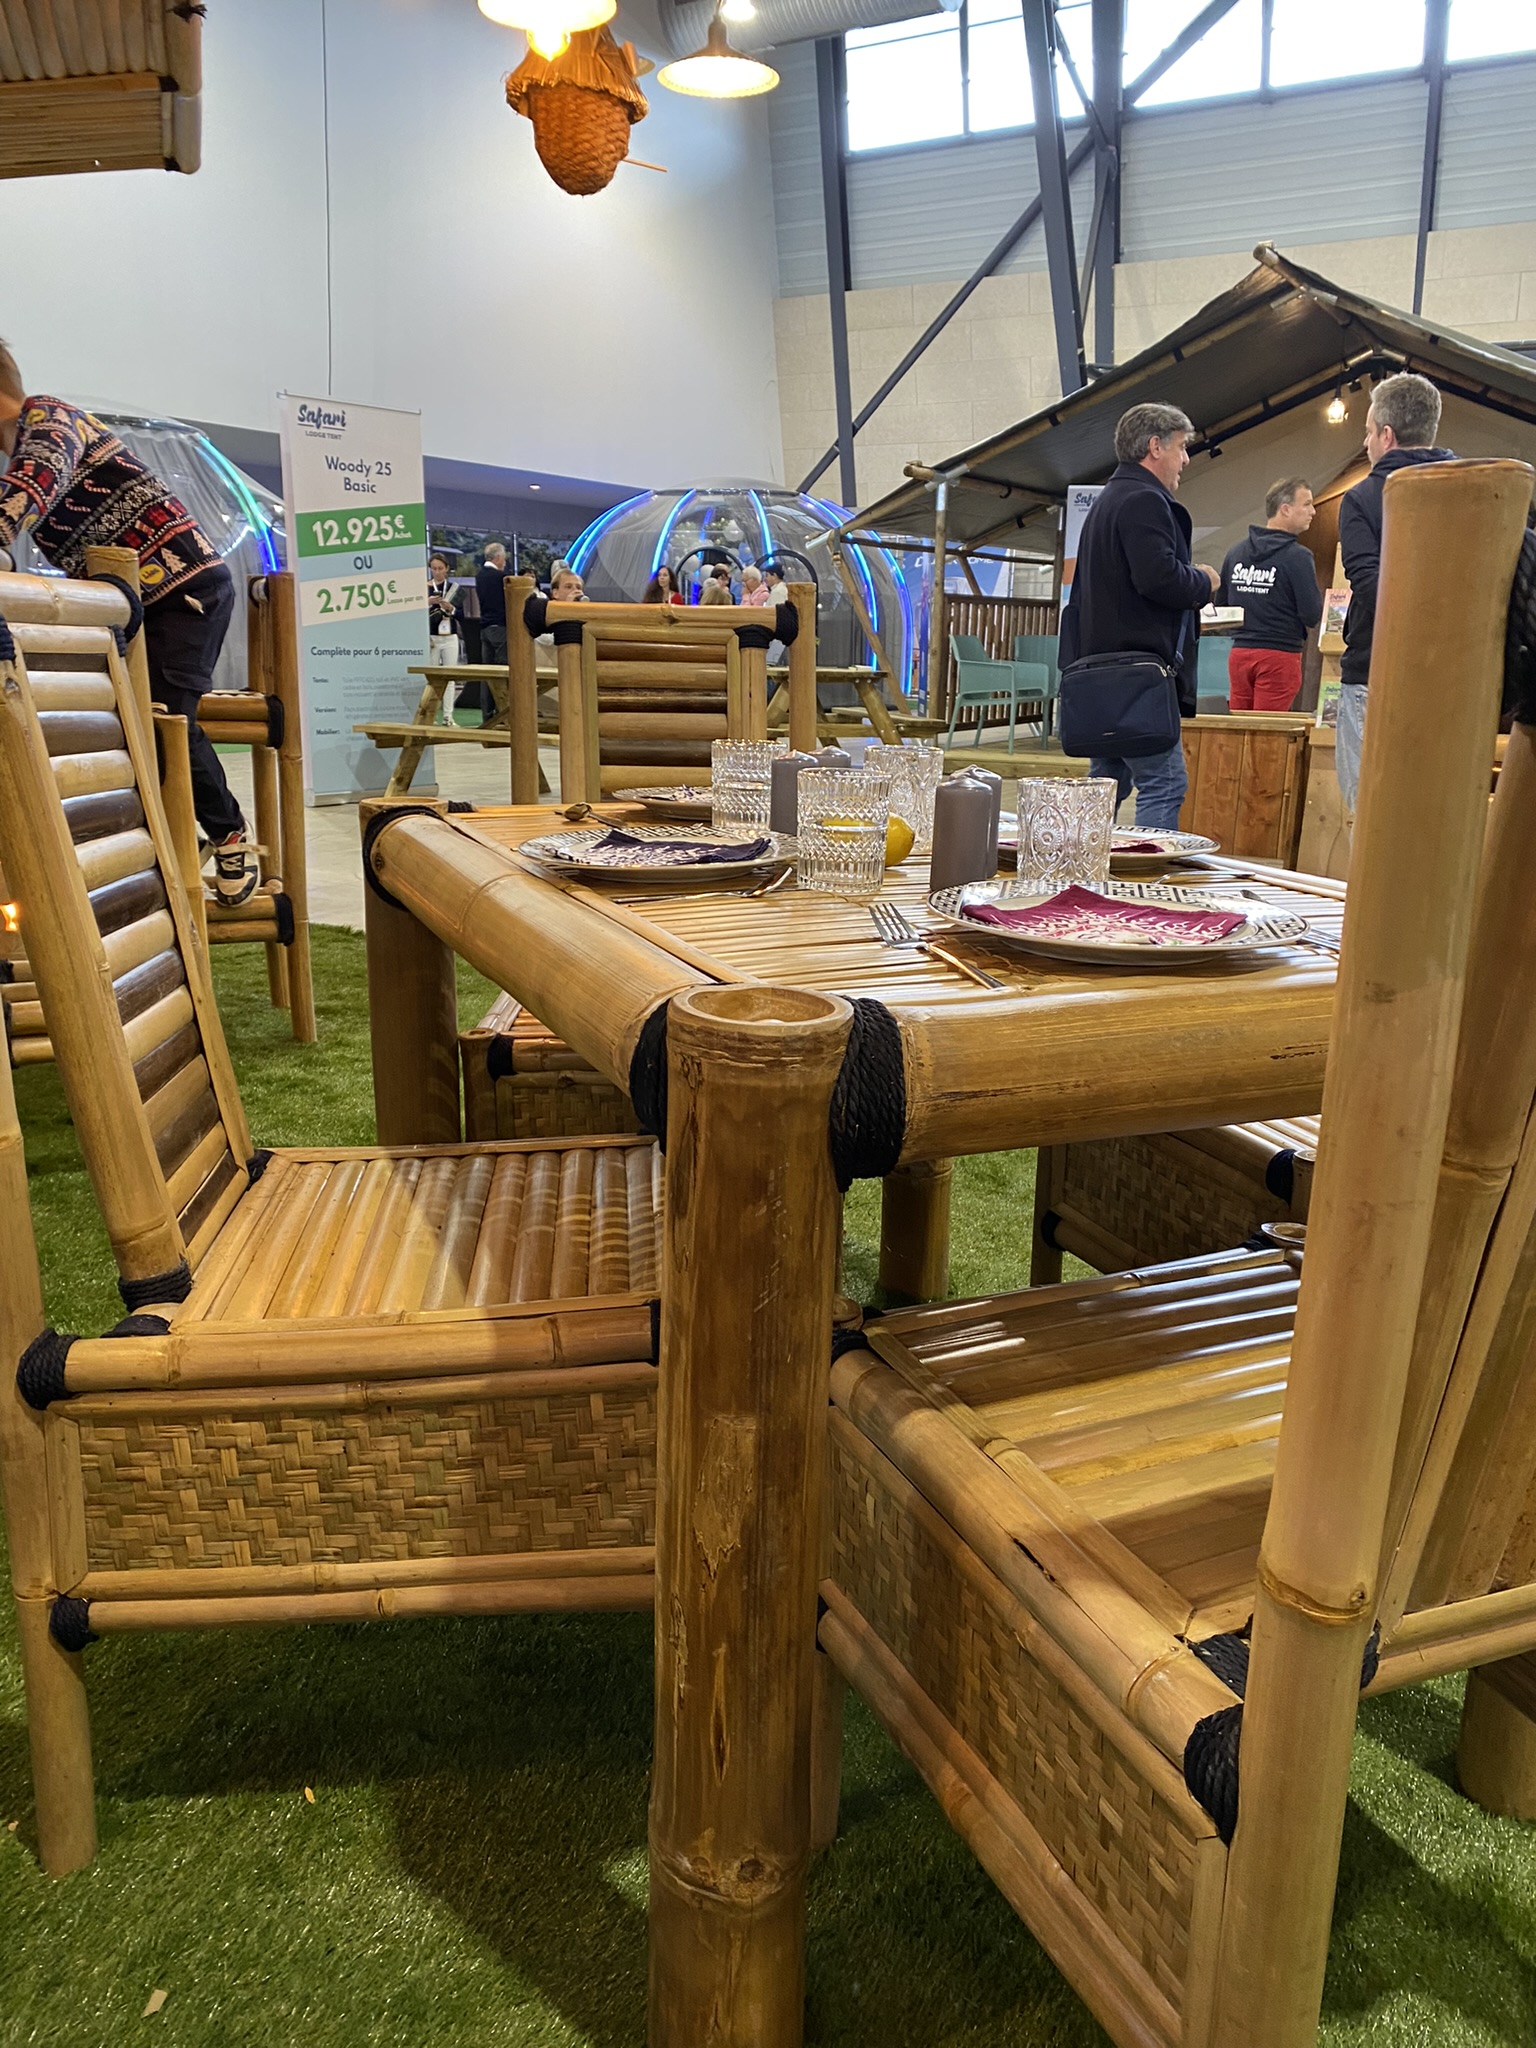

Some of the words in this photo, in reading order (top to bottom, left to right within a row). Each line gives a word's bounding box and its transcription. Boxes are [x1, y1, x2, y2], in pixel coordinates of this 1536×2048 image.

[298, 404, 346, 429] Safari
[324, 455, 371, 477] Woody
[375, 461, 392, 476] 25
[343, 477, 377, 493] Basic
[1074, 492, 1097, 507] Saf
[353, 555, 373, 570] OU
[1231, 562, 1277, 586] Safari
[310, 646, 351, 658] Complète
[353, 648, 373, 658] pour
[375, 647, 380, 656] 6
[381, 648, 424, 658] personnes:
